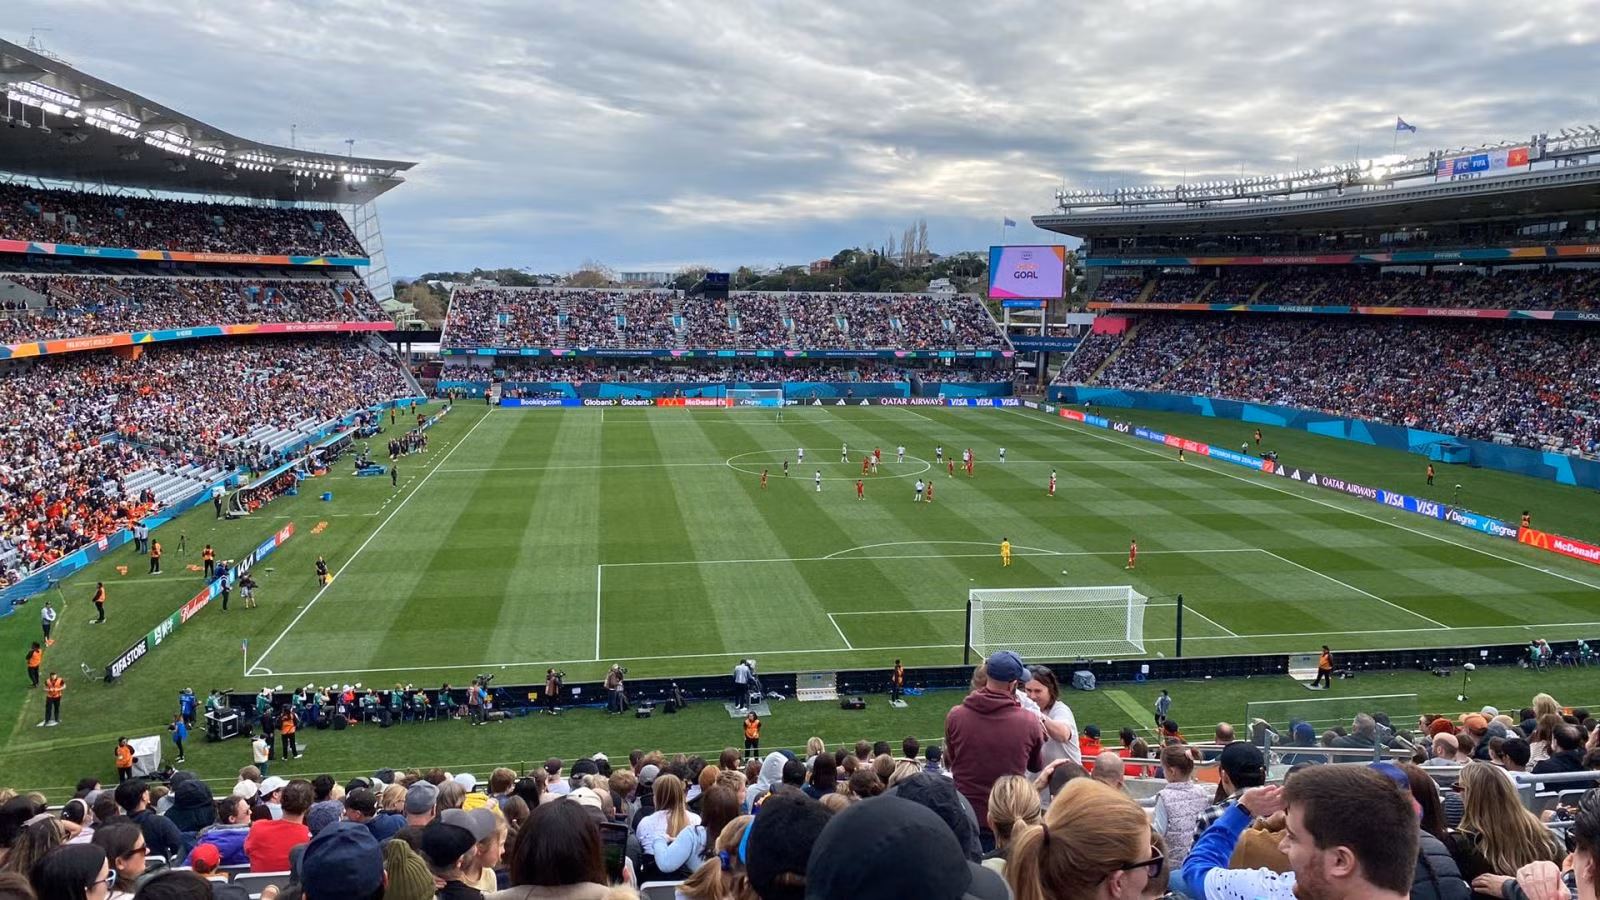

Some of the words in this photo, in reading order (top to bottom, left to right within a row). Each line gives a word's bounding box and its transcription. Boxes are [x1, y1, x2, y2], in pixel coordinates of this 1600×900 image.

[1472, 159, 1486, 168] FIFA
[1013, 271, 1038, 279] GOAL
[520, 398, 562, 407] Booking.com
[880, 398, 907, 406] QATAR
[1322, 476, 1344, 491] QATAR
[1346, 483, 1377, 499] AIRWAYS
[1383, 490, 1405, 508] VISA
[1415, 499, 1438, 518] VISA
[1452, 511, 1477, 527] Degree
[1490, 522, 1517, 538] Degree
[126, 640, 147, 666] STORE
